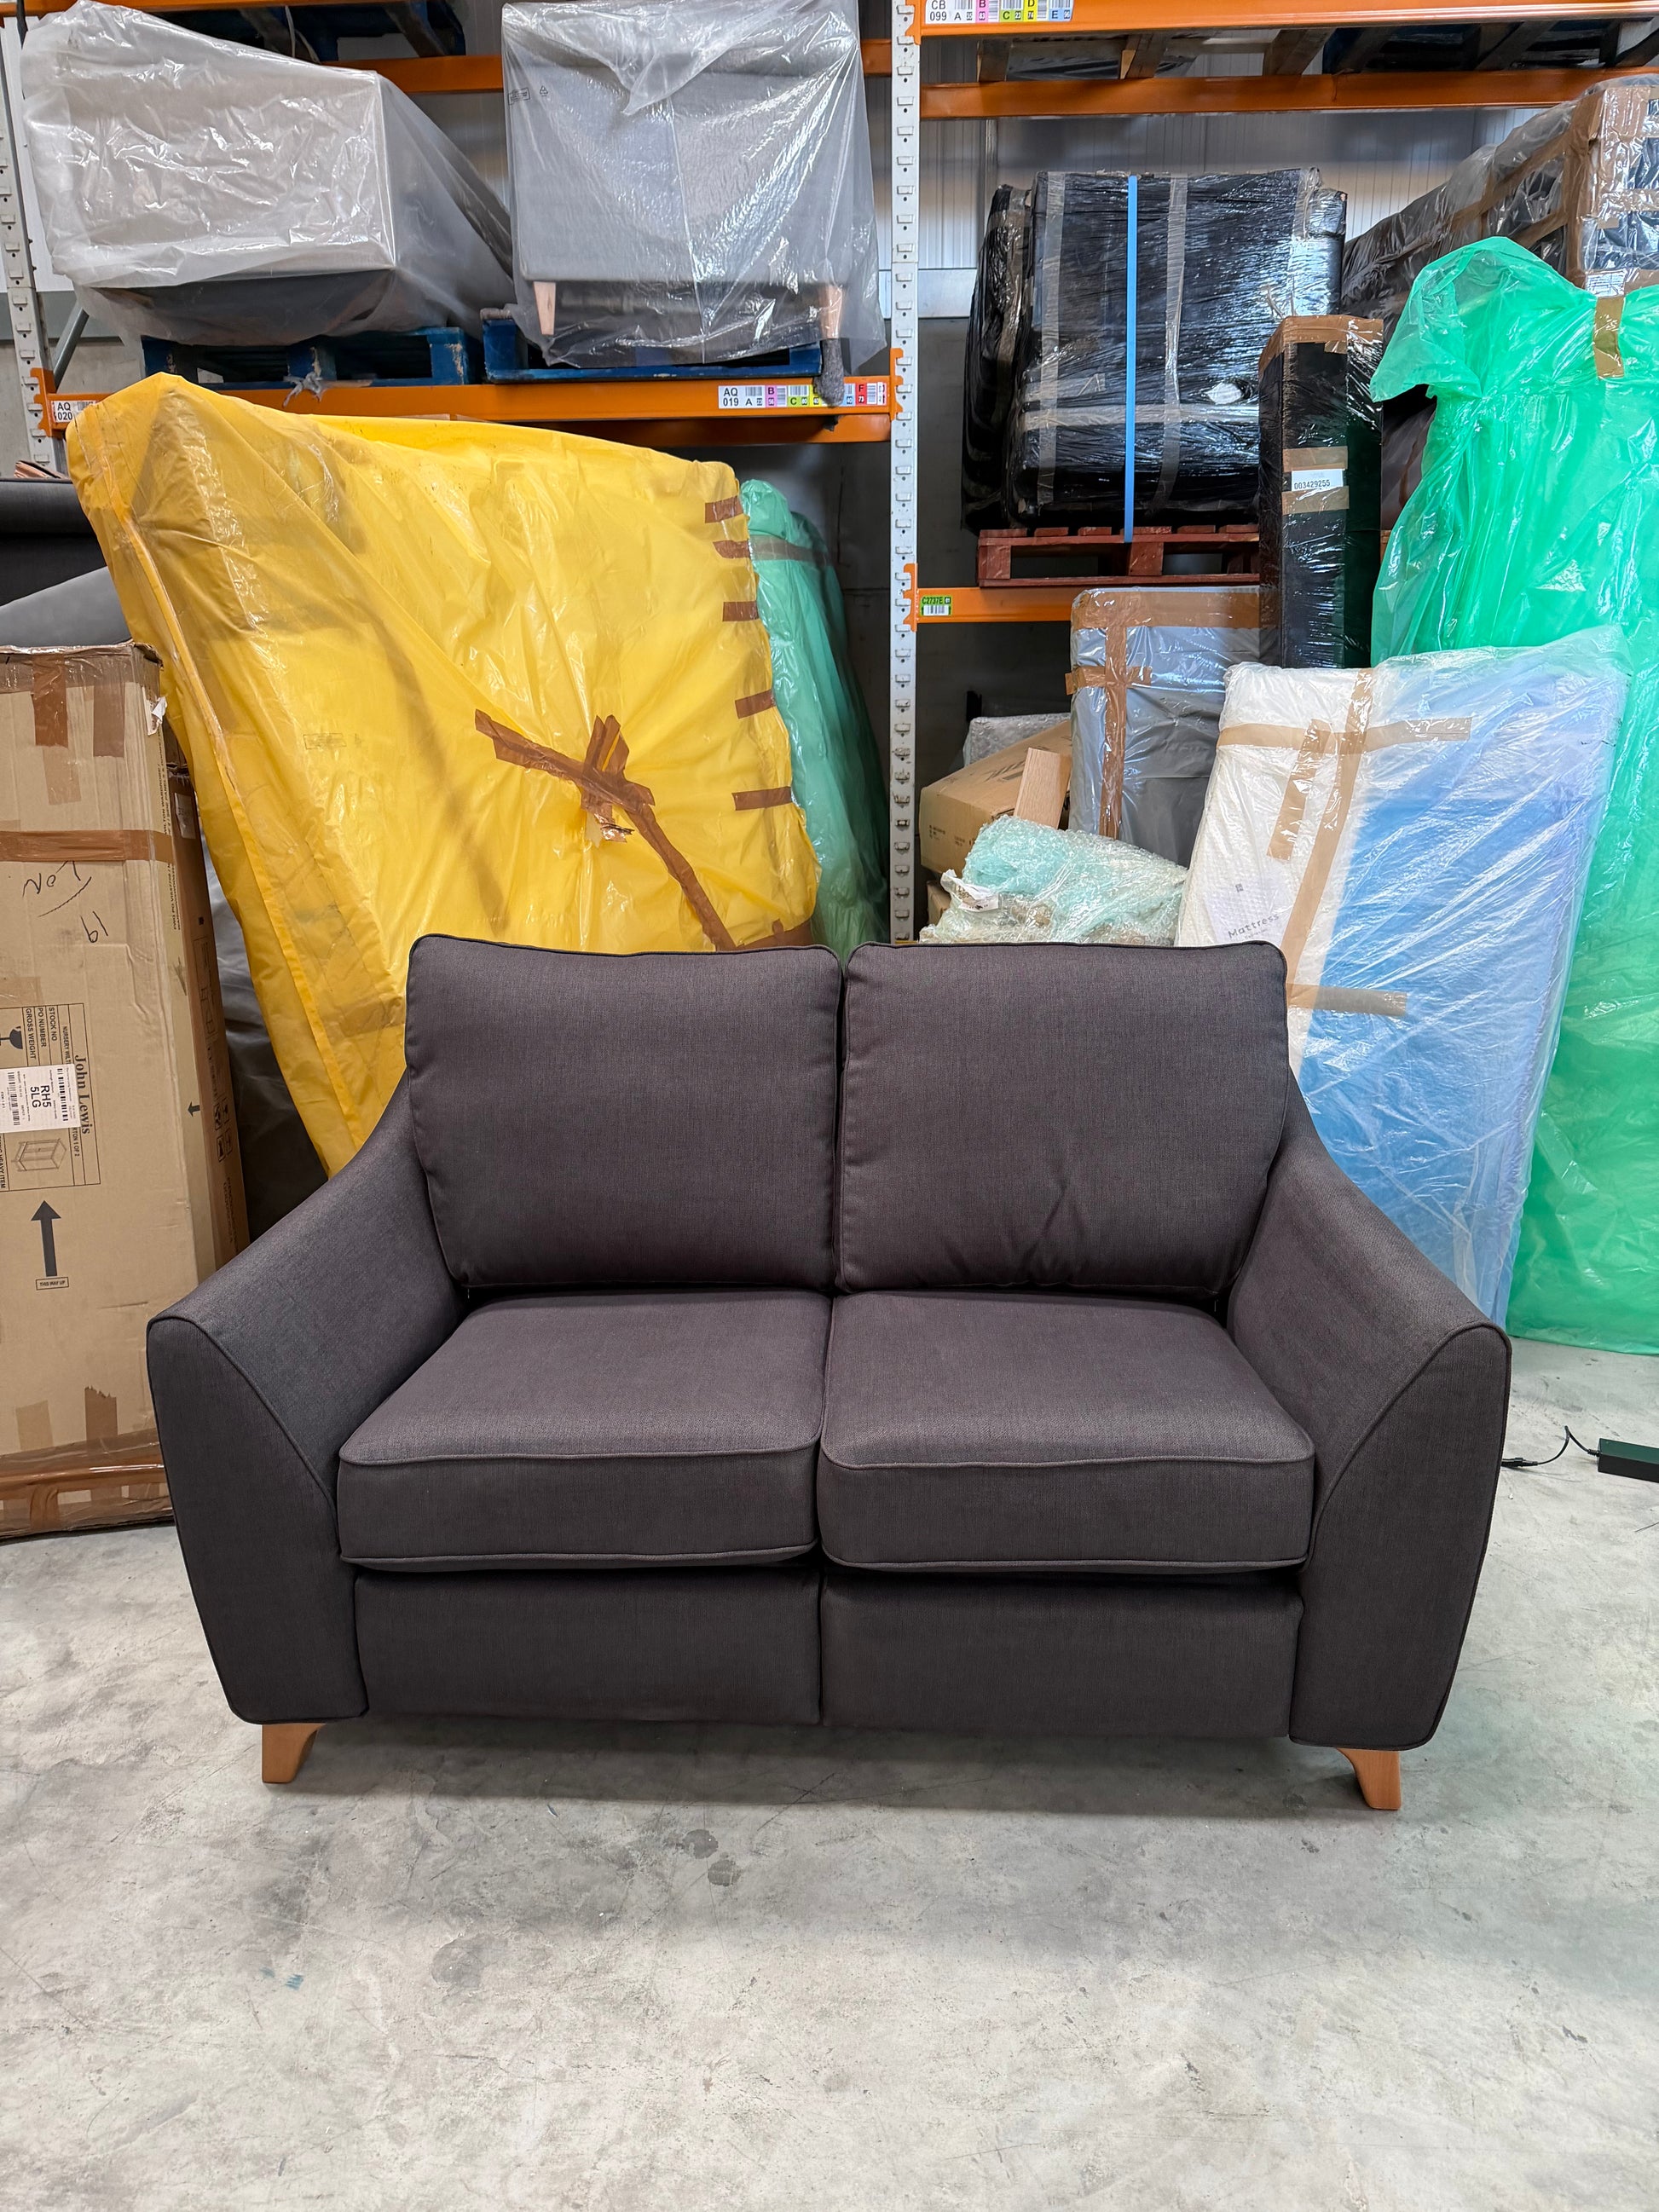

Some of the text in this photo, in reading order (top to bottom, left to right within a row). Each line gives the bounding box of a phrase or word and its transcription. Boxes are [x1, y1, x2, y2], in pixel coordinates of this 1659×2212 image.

[931, 0, 945, 9] CB
[929, 11, 947, 21] 099
[954, 12, 962, 20] A
[1003, 11, 1010, 20] C
[1052, 10, 1058, 19] E
[723, 388, 738, 396] AQ
[57, 401, 72, 411] AQ
[57, 412, 73, 420] 020
[1228, 914, 1280, 939] Mattress
[38, 1008, 47, 1048] PO NUMBER
[26, 1008, 37, 1060] GROSS WEIGHT
[51, 1031, 58, 1041] NO
[30, 1086, 42, 1108] 5LG
[40, 1085, 52, 1107] RH5
[75, 1055, 93, 1135] John Lewis
